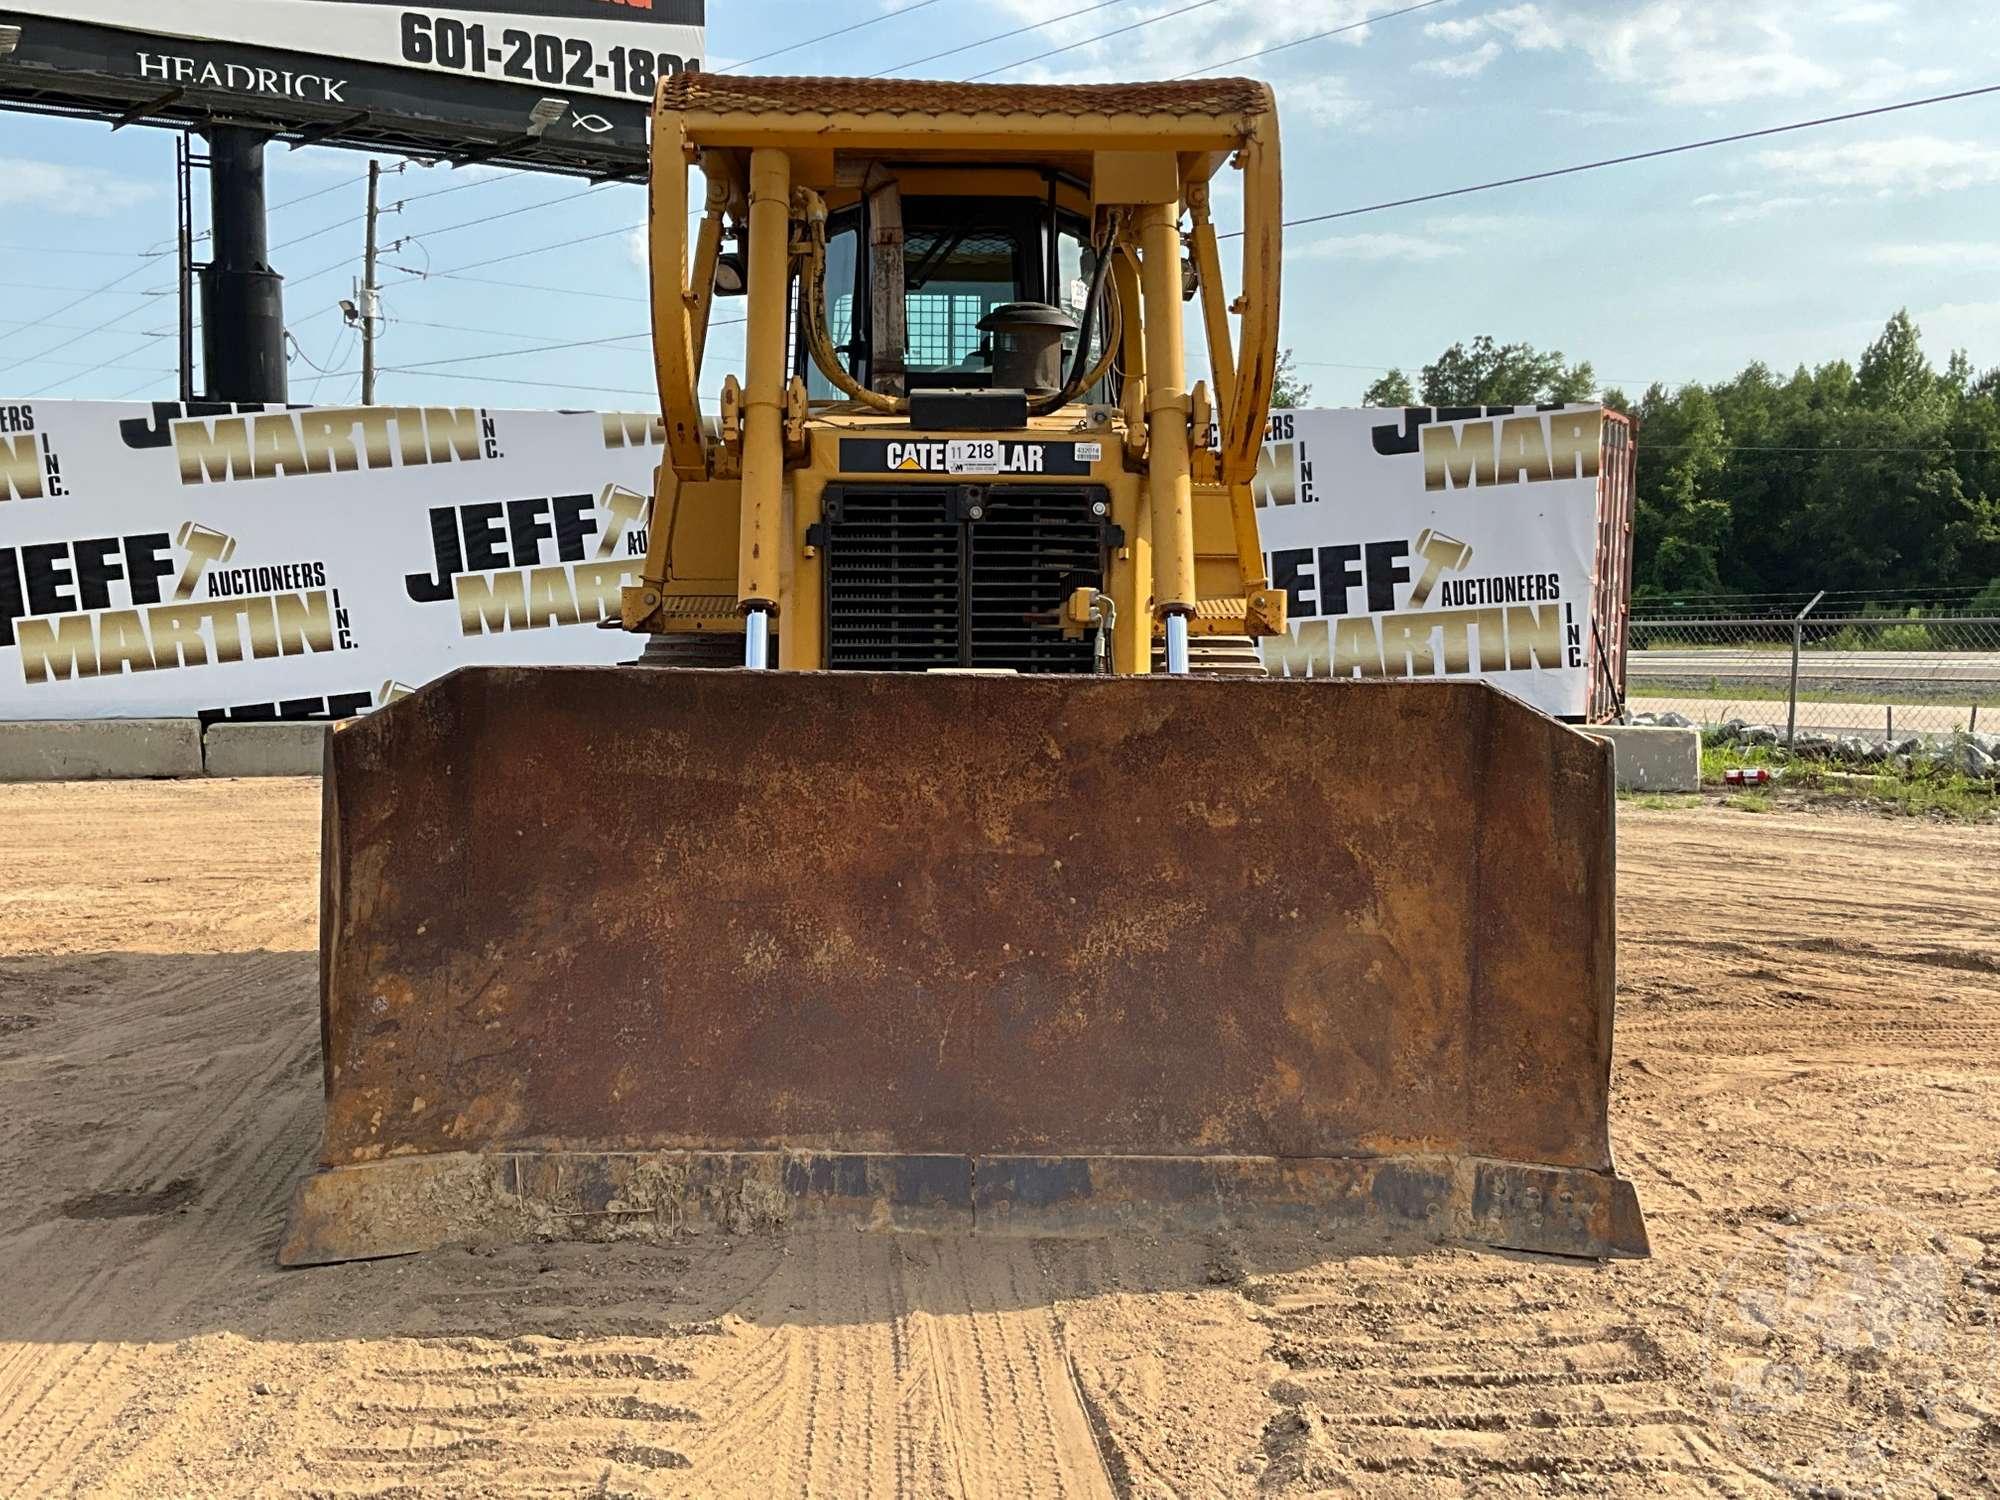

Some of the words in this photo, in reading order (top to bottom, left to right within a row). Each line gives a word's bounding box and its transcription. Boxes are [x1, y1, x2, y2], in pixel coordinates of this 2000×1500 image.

[136, 52, 348, 103] HEADRICK
[400, 11, 700, 97] 601-202-18
[41, 433, 70, 497] INC.
[172, 407, 480, 486] MARTIN
[886, 442, 1044, 473] CATELAR
[967, 443, 994, 459] 218
[1299, 441, 1319, 504] INC.
[208, 561, 326, 598] AUCTIONEERS
[405, 493, 599, 603] JEFF
[1263, 539, 1411, 619] EFF
[332, 589, 359, 651] INC.
[1441, 573, 1560, 608] AUCTIONEERS
[17, 591, 335, 684] MARTIN
[1565, 602, 1589, 669] INC.
